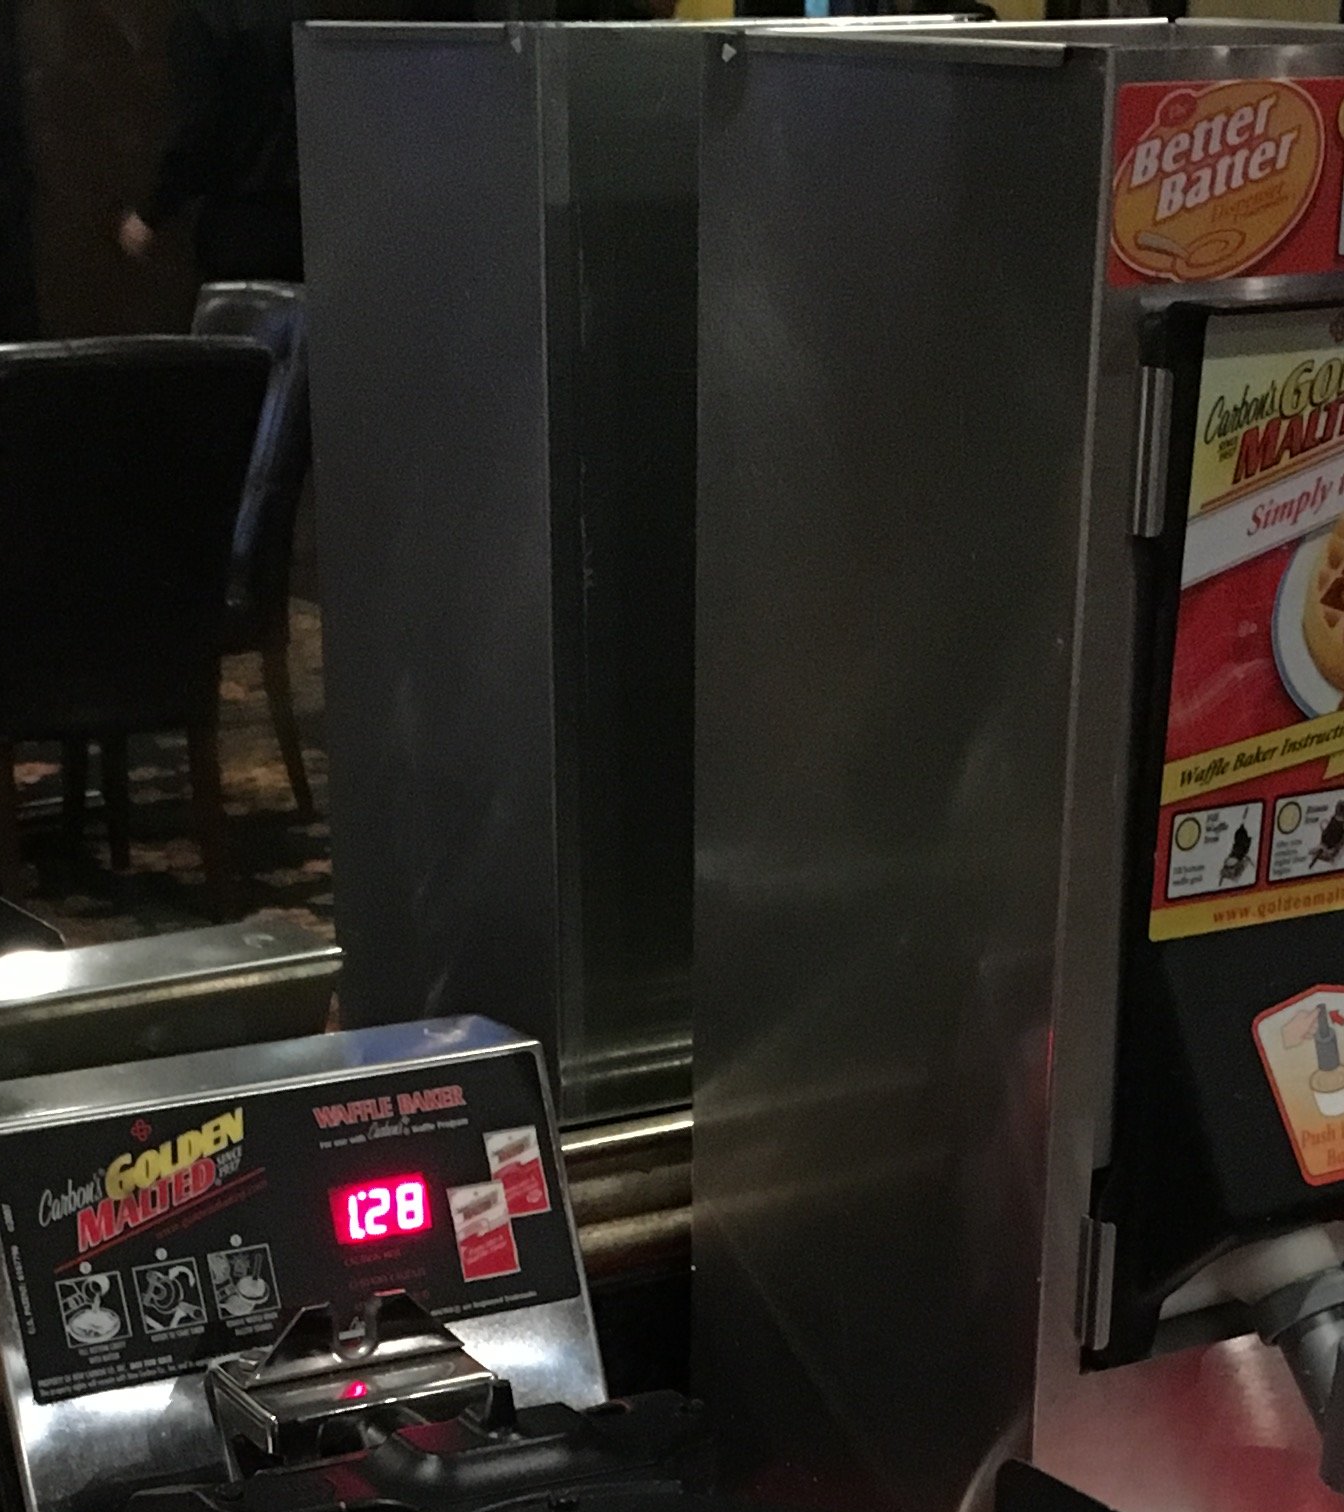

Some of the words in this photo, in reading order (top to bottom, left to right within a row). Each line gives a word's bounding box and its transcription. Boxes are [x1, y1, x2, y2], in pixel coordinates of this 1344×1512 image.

[1130, 94, 1278, 188] Better
[1155, 125, 1301, 222] Batter
[1246, 477, 1332, 538] Simply
[1179, 757, 1231, 787] Waffle
[1233, 745, 1278, 775] Baker
[312, 1096, 394, 1129] WAFFLE
[397, 1084, 467, 1115] BAKER
[106, 1107, 244, 1199] GOLDEN
[76, 1157, 216, 1253] MALTED
